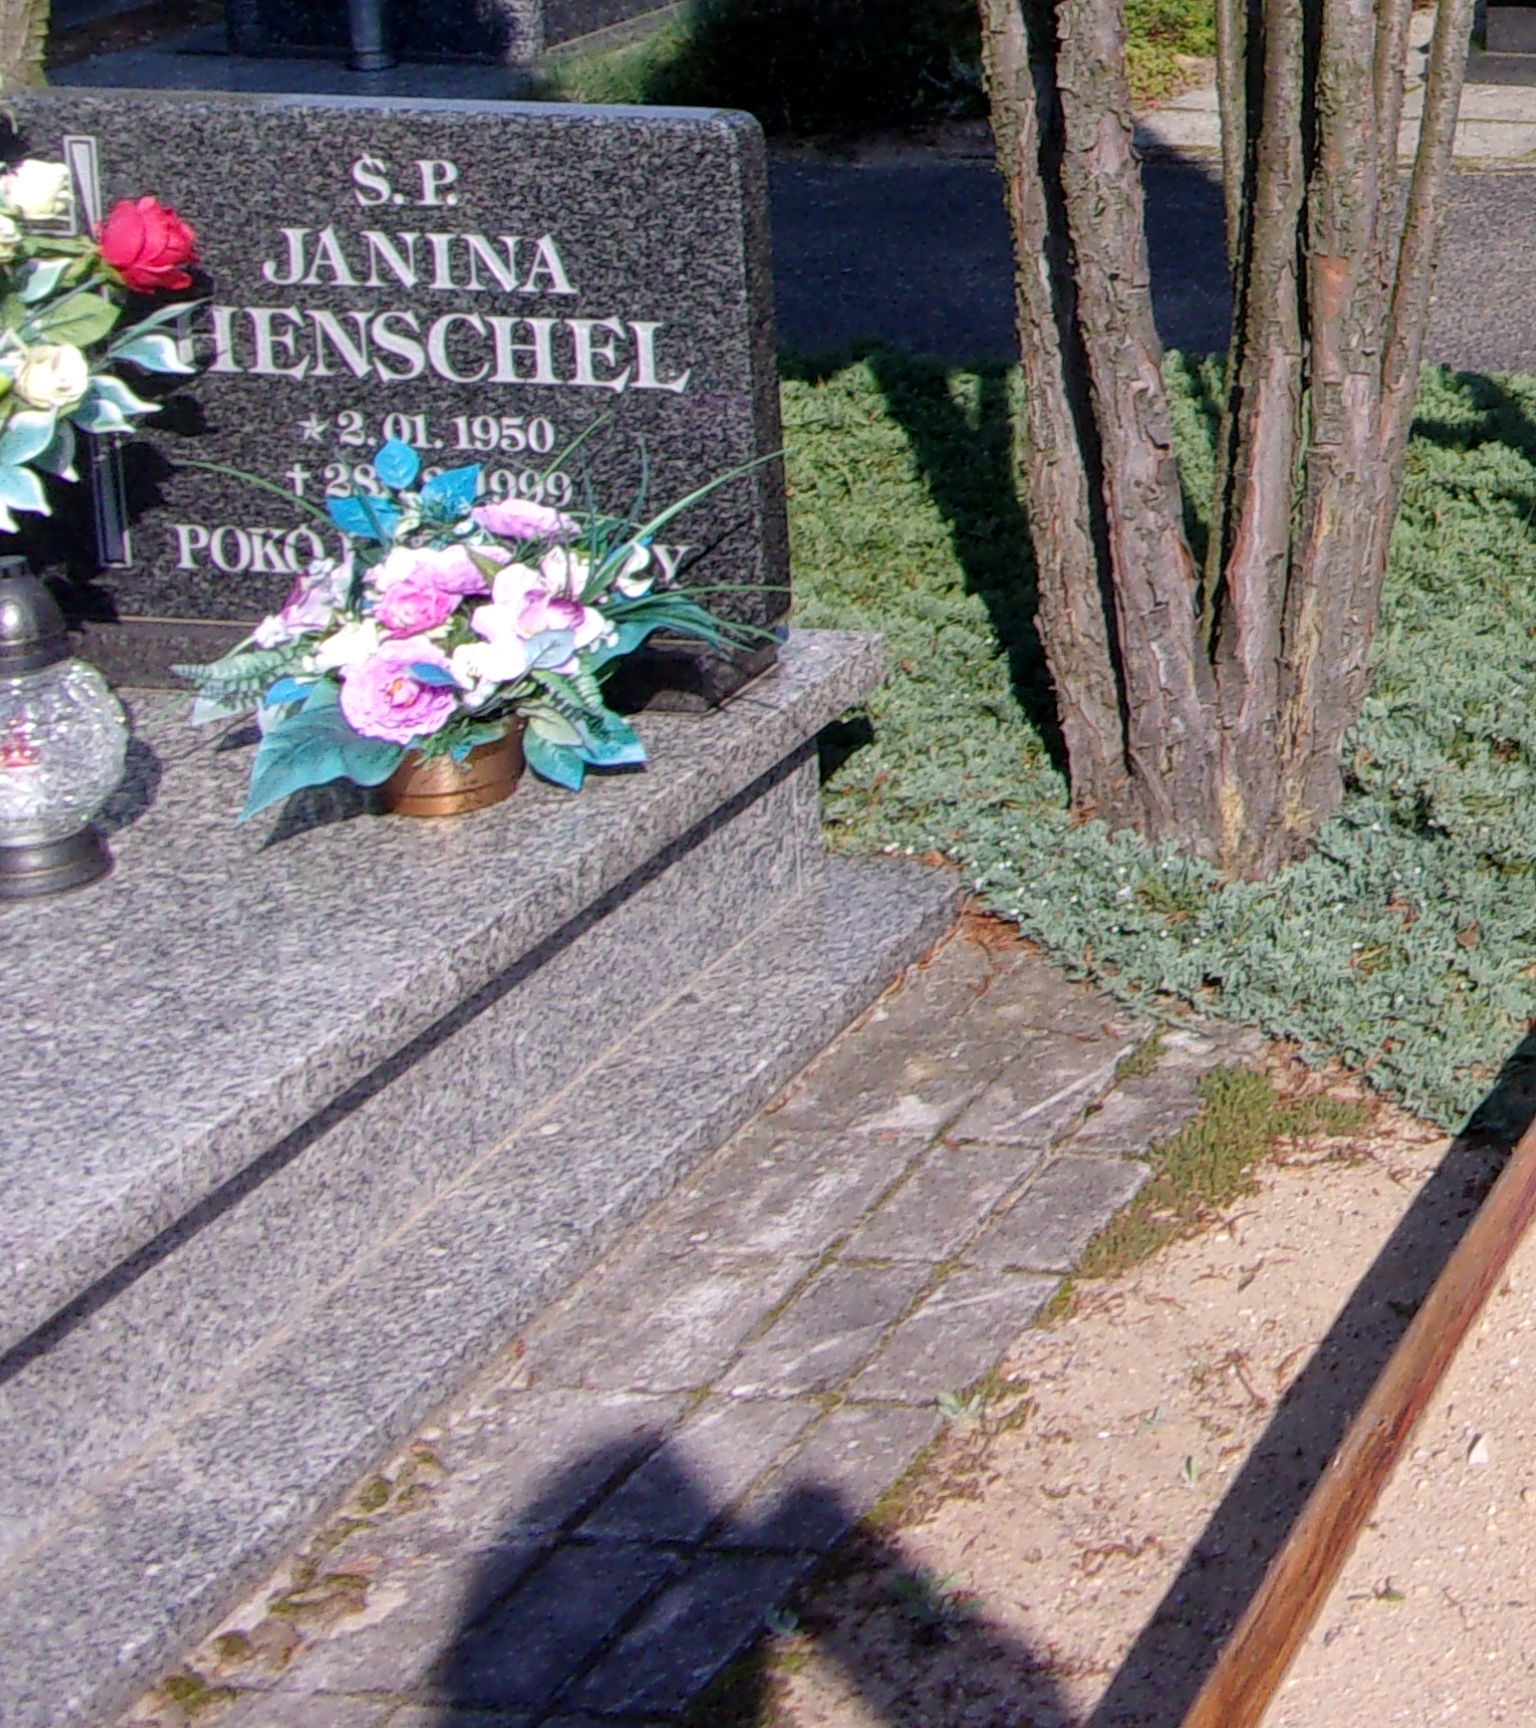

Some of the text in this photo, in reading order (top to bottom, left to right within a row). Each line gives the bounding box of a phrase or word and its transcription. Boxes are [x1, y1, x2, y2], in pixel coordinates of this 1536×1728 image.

[262, 223, 579, 295] JANINA
[176, 304, 692, 393] HENSCHEL
[336, 410, 377, 447] 2.
[450, 414, 555, 454] 1950
